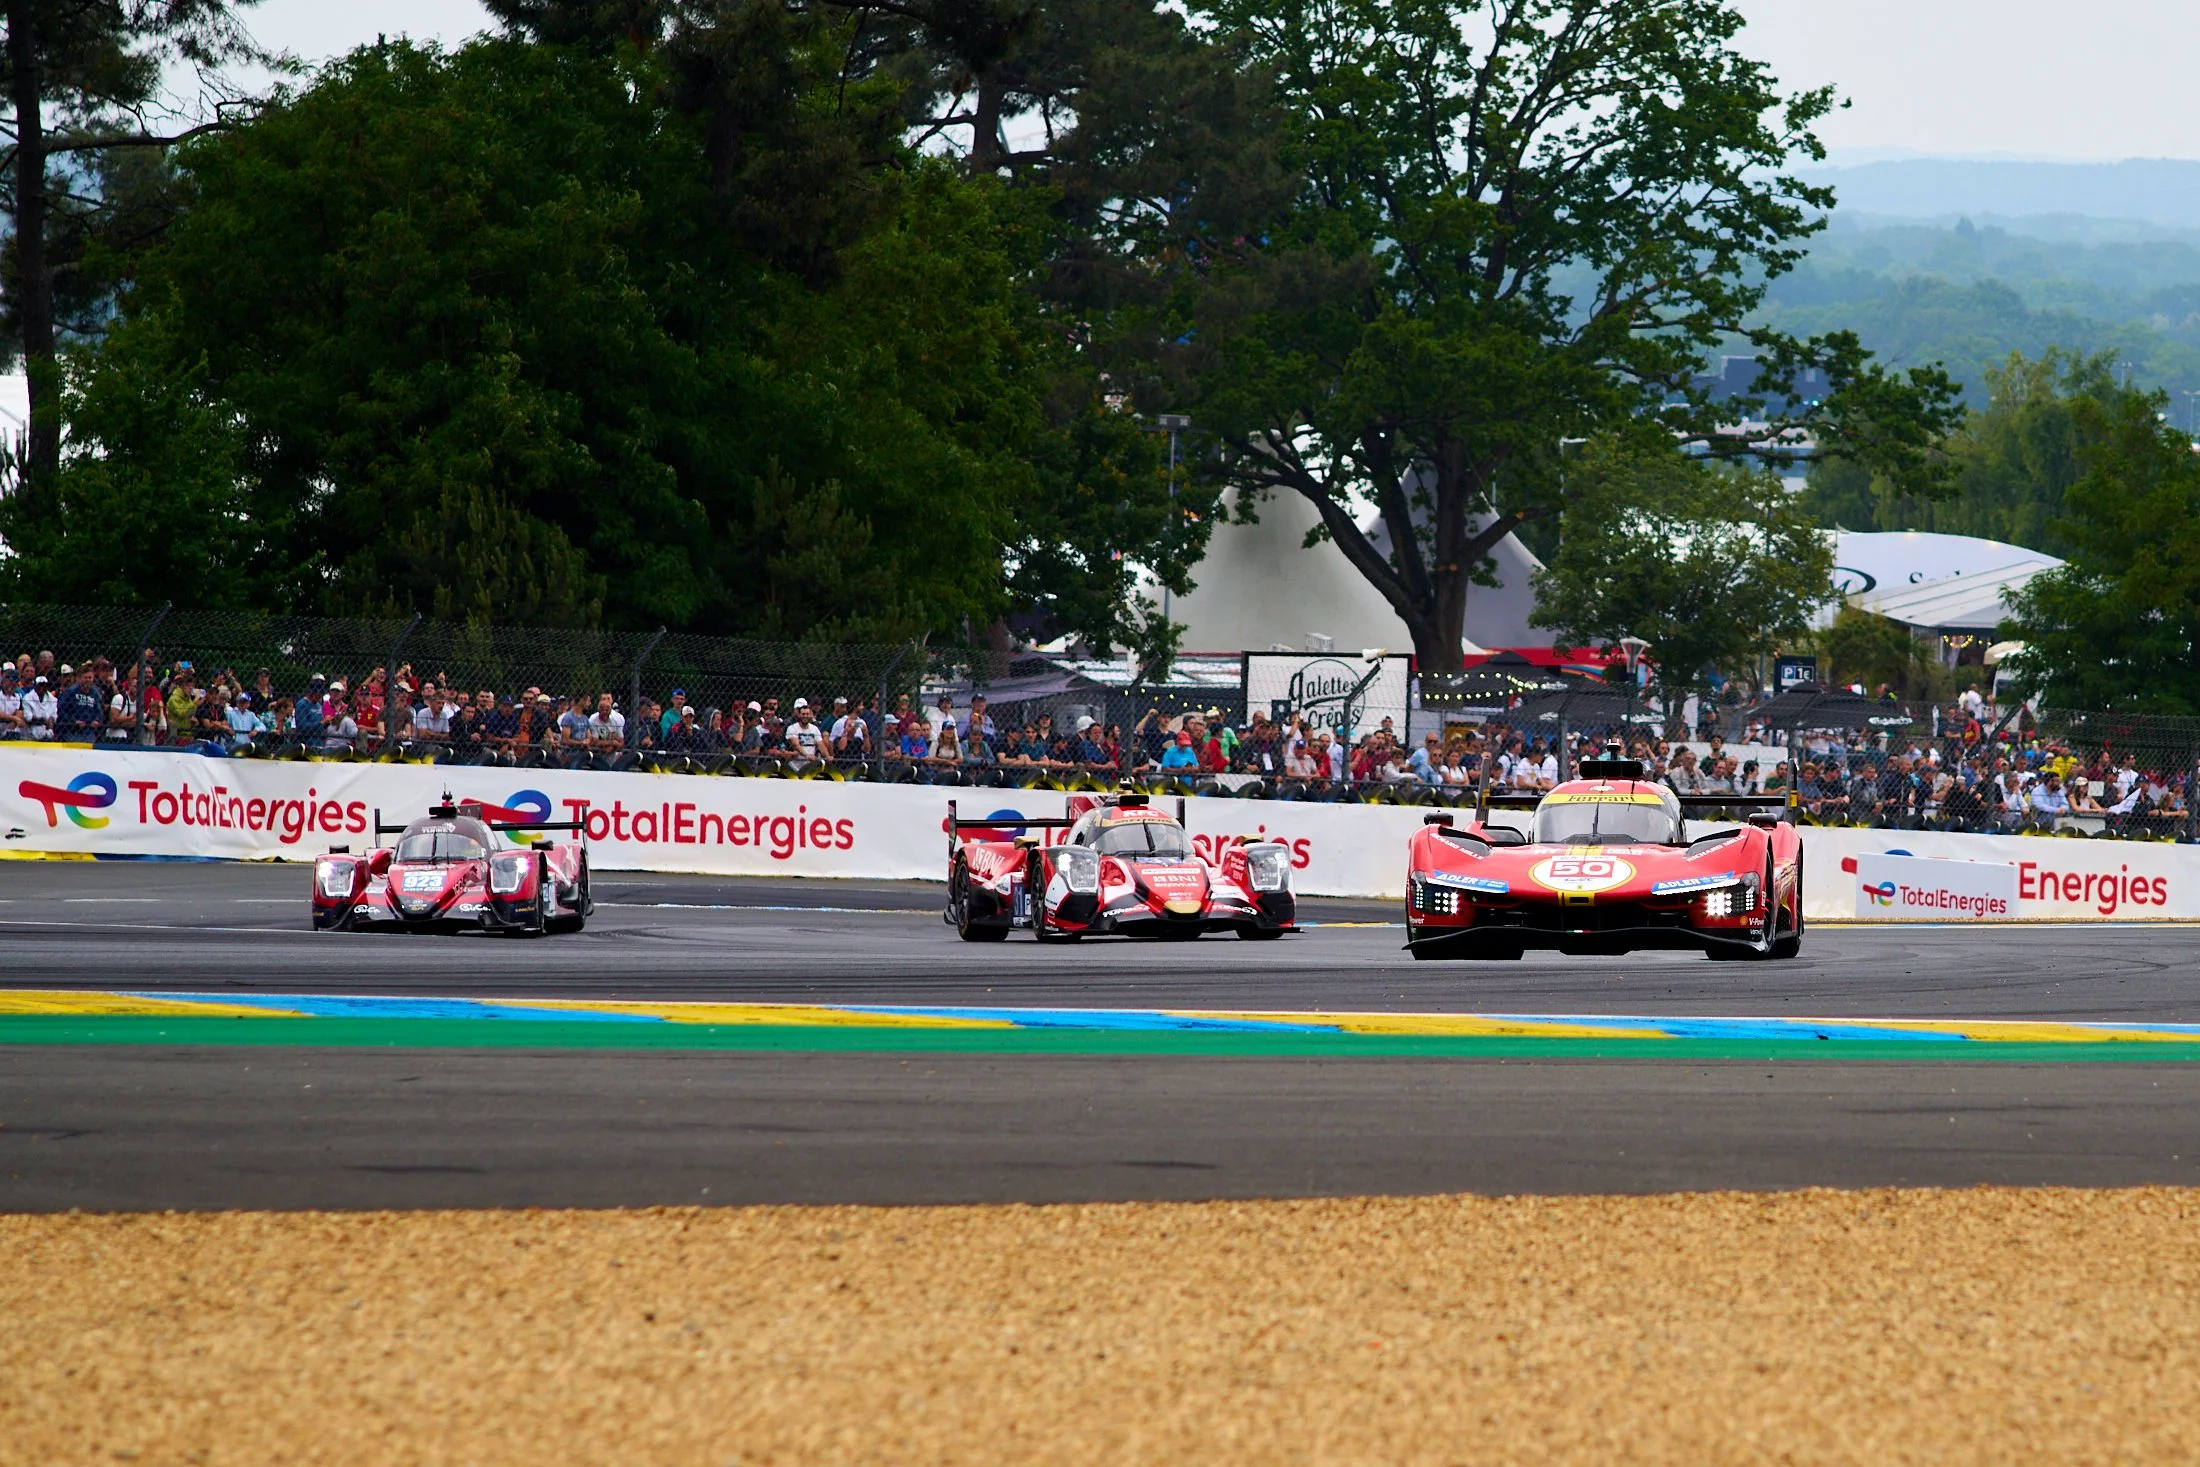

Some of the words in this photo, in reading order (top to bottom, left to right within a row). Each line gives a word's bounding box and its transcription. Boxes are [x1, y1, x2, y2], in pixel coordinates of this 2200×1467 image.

[1784, 667, 1794, 679] P
[1797, 667, 1811, 680] 1€
[1308, 706, 1361, 731] Crêps
[1568, 794, 1636, 802] Ferrari
[128, 780, 367, 844] TotalEnergies
[562, 798, 855, 860] TotalEnergies
[980, 850, 1005, 875] BNI
[1552, 861, 1611, 875] 50
[403, 876, 443, 888] 923
[1436, 873, 1479, 885] ADLER
[1657, 878, 1700, 889] ADLER
[2009, 861, 2168, 914] Energies
[1900, 885, 2007, 917] TotalEnergies
